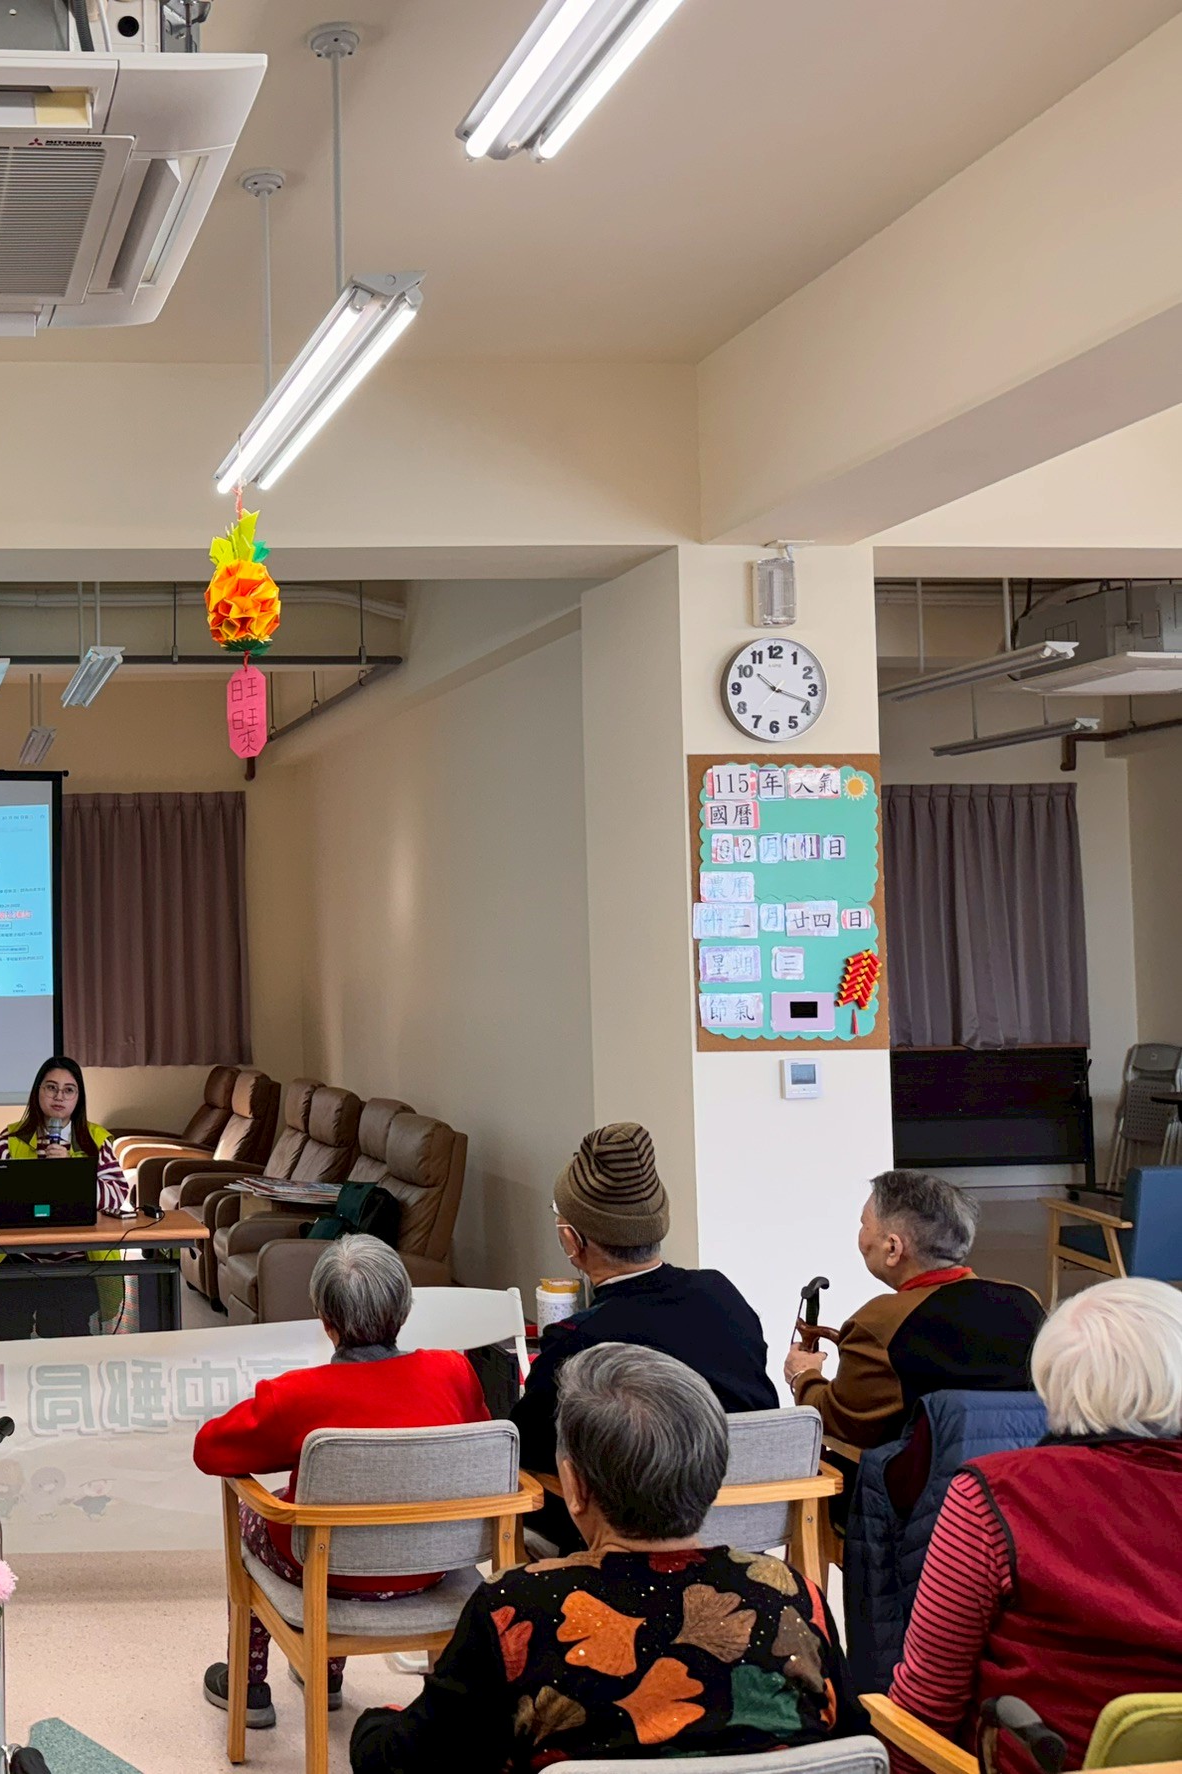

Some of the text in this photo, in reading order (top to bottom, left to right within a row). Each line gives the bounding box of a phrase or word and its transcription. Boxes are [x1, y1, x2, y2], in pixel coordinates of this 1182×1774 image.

[750, 650, 763, 664] 11
[767, 645, 783, 659] 12
[791, 651, 798, 665] 1
[737, 665, 754, 678] 10
[802, 666, 813, 680] 2
[731, 682, 742, 695] 9
[807, 683, 818, 697] 3
[737, 701, 747, 714] 8
[801, 700, 811, 716] 4
[231, 677, 258, 753] 旺旺來
[751, 715, 762, 728] 7
[769, 720, 780, 734] 6
[788, 716, 798, 729] 5
